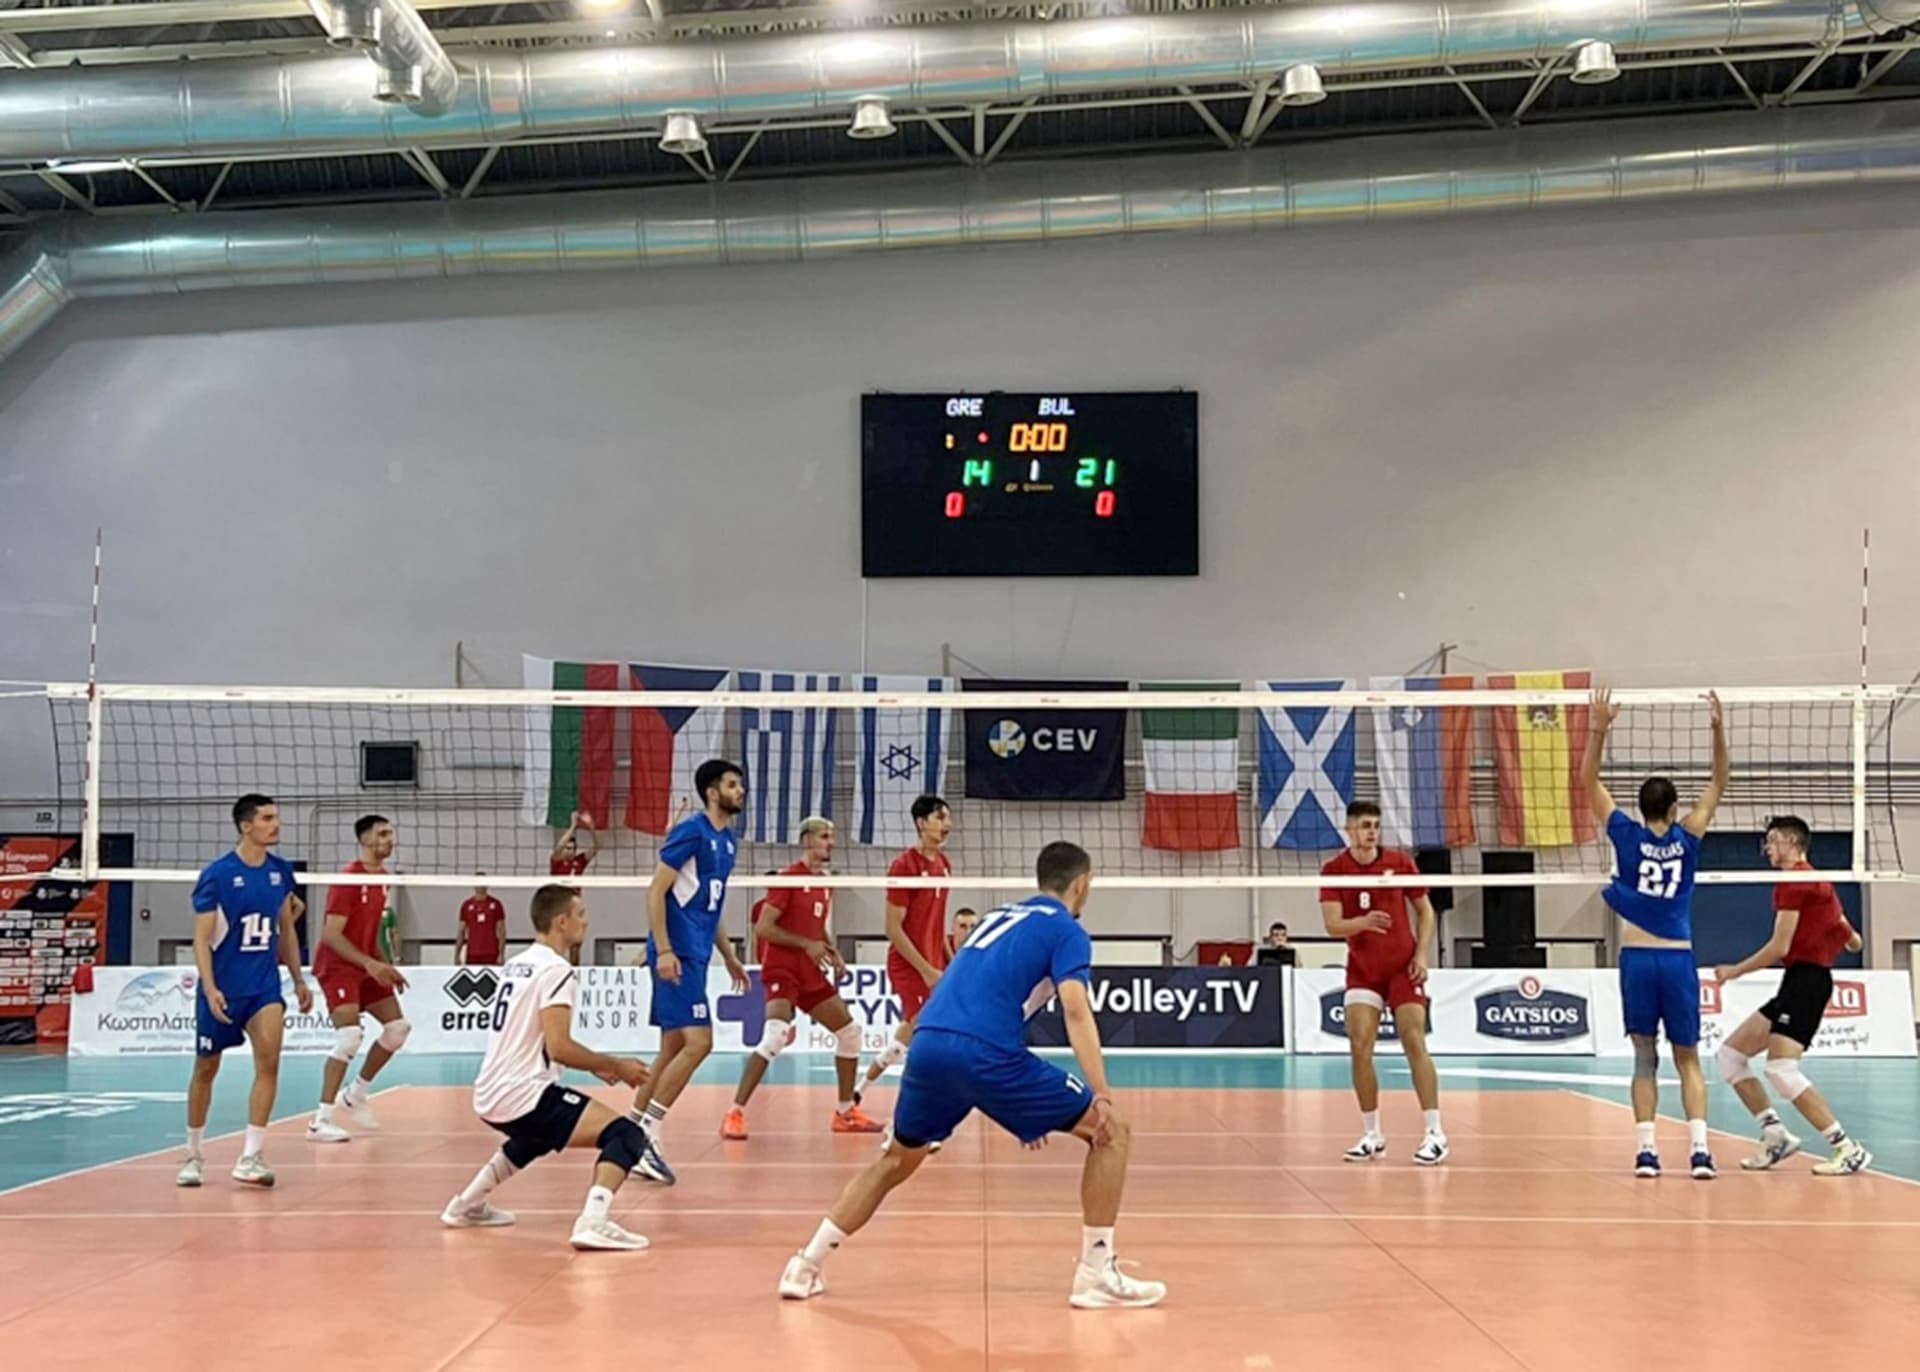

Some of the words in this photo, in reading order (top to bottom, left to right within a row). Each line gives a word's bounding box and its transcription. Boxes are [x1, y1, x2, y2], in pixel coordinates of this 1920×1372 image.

[946, 398, 984, 417] GRE
[1038, 398, 1075, 416] BUL
[1009, 423, 1068, 451] 0:00
[963, 459, 991, 486] 14
[1030, 459, 1039, 481] 1
[1076, 458, 1115, 487] 21
[946, 492, 963, 517] 0
[1096, 491, 1115, 516] 0
[1032, 727, 1097, 751] CEV
[1637, 860, 1682, 898] 27
[1359, 891, 1370, 909] 8
[240, 912, 272, 946] 14
[962, 911, 1031, 949] 17
[577, 968, 638, 986] ICIAL
[493, 982, 513, 1032] 6
[581, 989, 638, 1007] NICAL
[442, 1011, 490, 1030] erre
[579, 1010, 638, 1029] NSOR
[1485, 1006, 1579, 1023] GATSIOS
